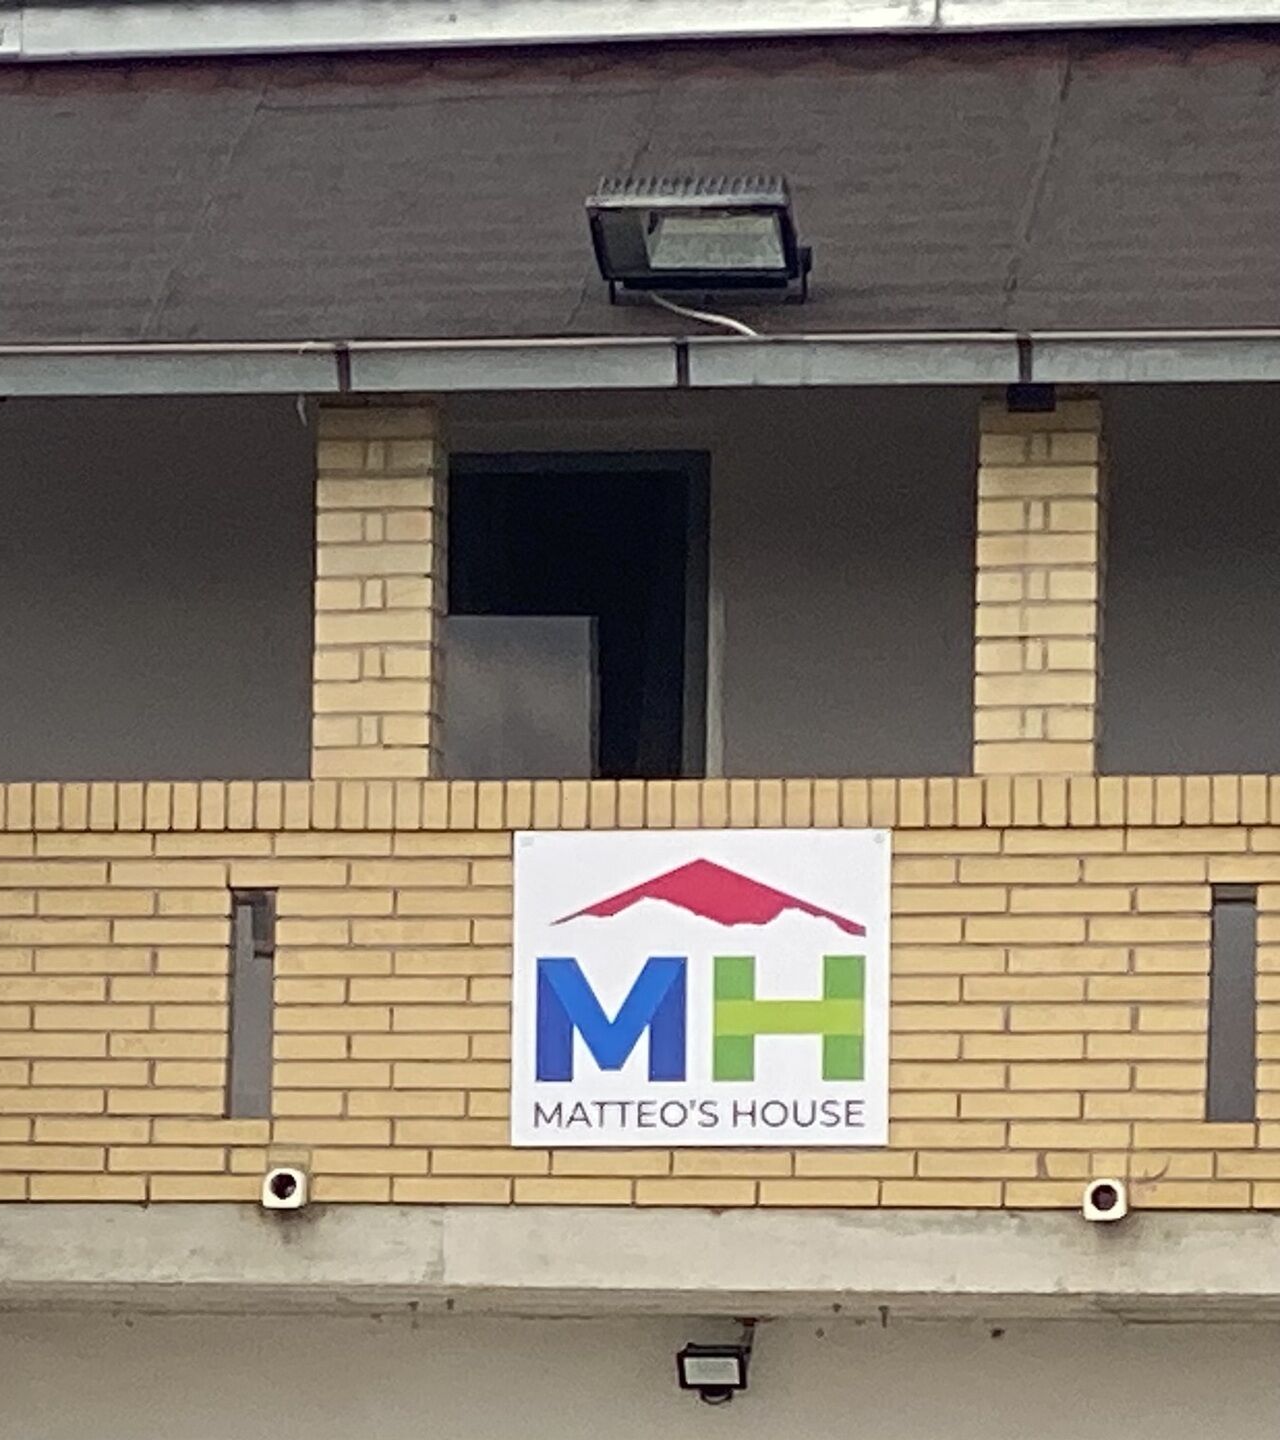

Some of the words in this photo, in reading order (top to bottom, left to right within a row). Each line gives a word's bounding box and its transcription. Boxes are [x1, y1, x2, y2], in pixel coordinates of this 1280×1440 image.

[535, 956, 866, 1083] MH
[533, 1099, 720, 1129] MATTEO'S
[732, 1098, 865, 1128] HOUSE
